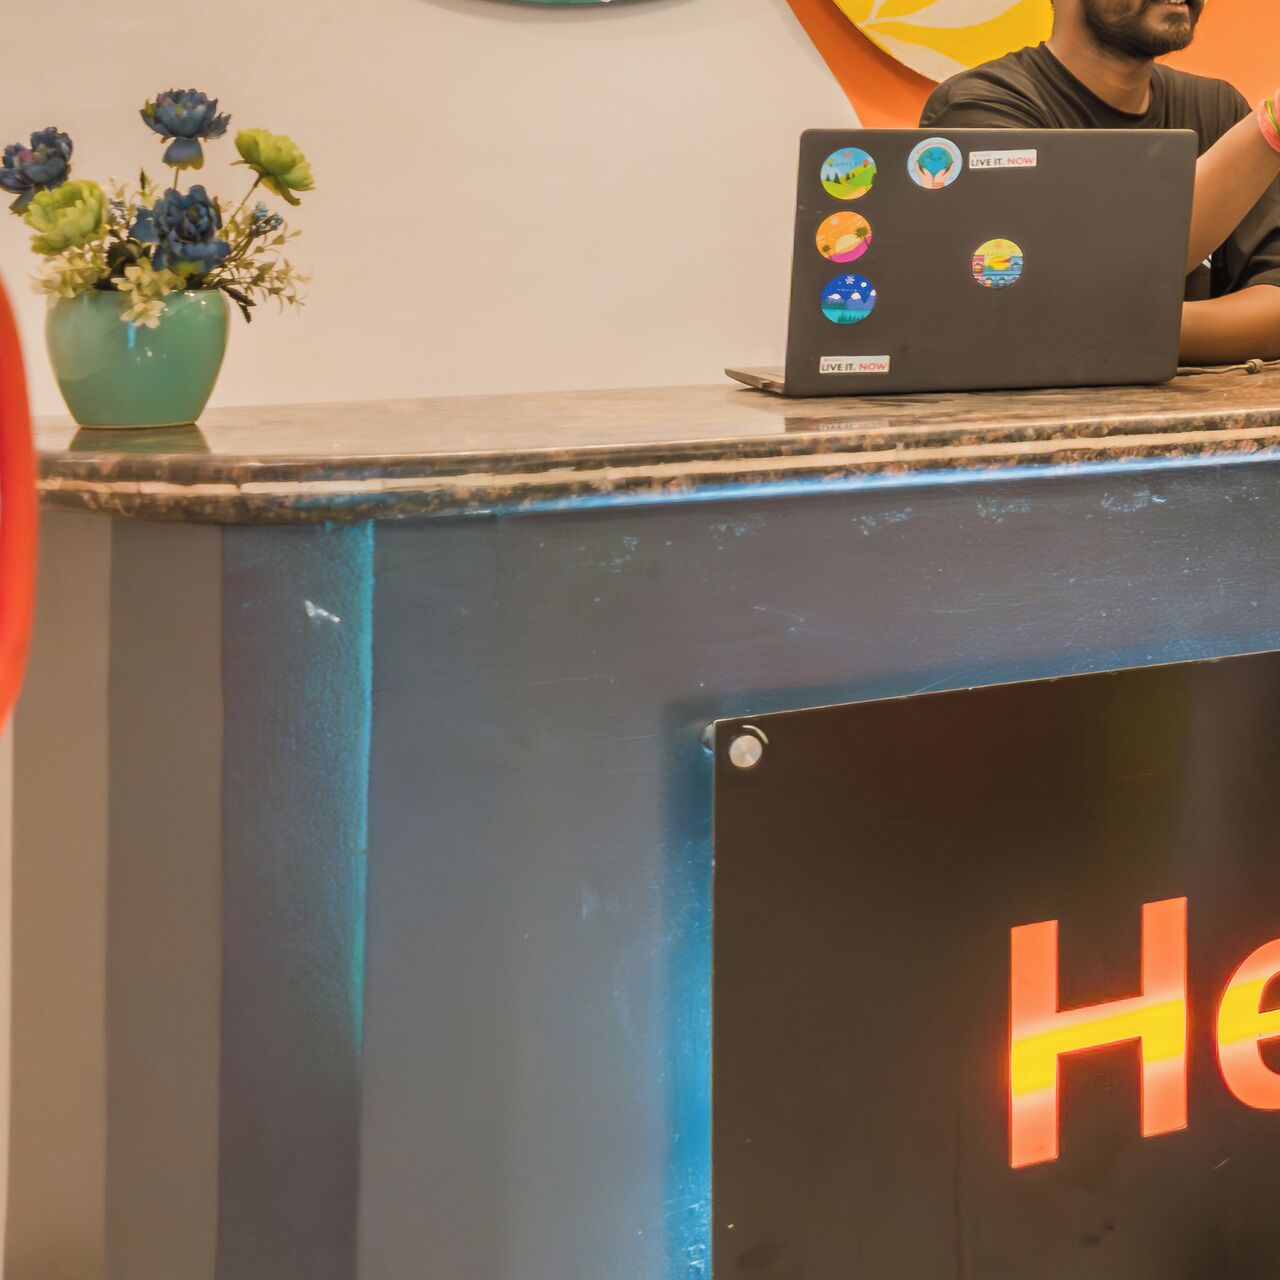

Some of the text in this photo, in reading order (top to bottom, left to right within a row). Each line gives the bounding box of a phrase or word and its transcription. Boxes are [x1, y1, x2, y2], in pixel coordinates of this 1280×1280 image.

[1008, 157, 1034, 165] NOW
[821, 363, 843, 371] LIVE
[859, 362, 887, 370] NOW
